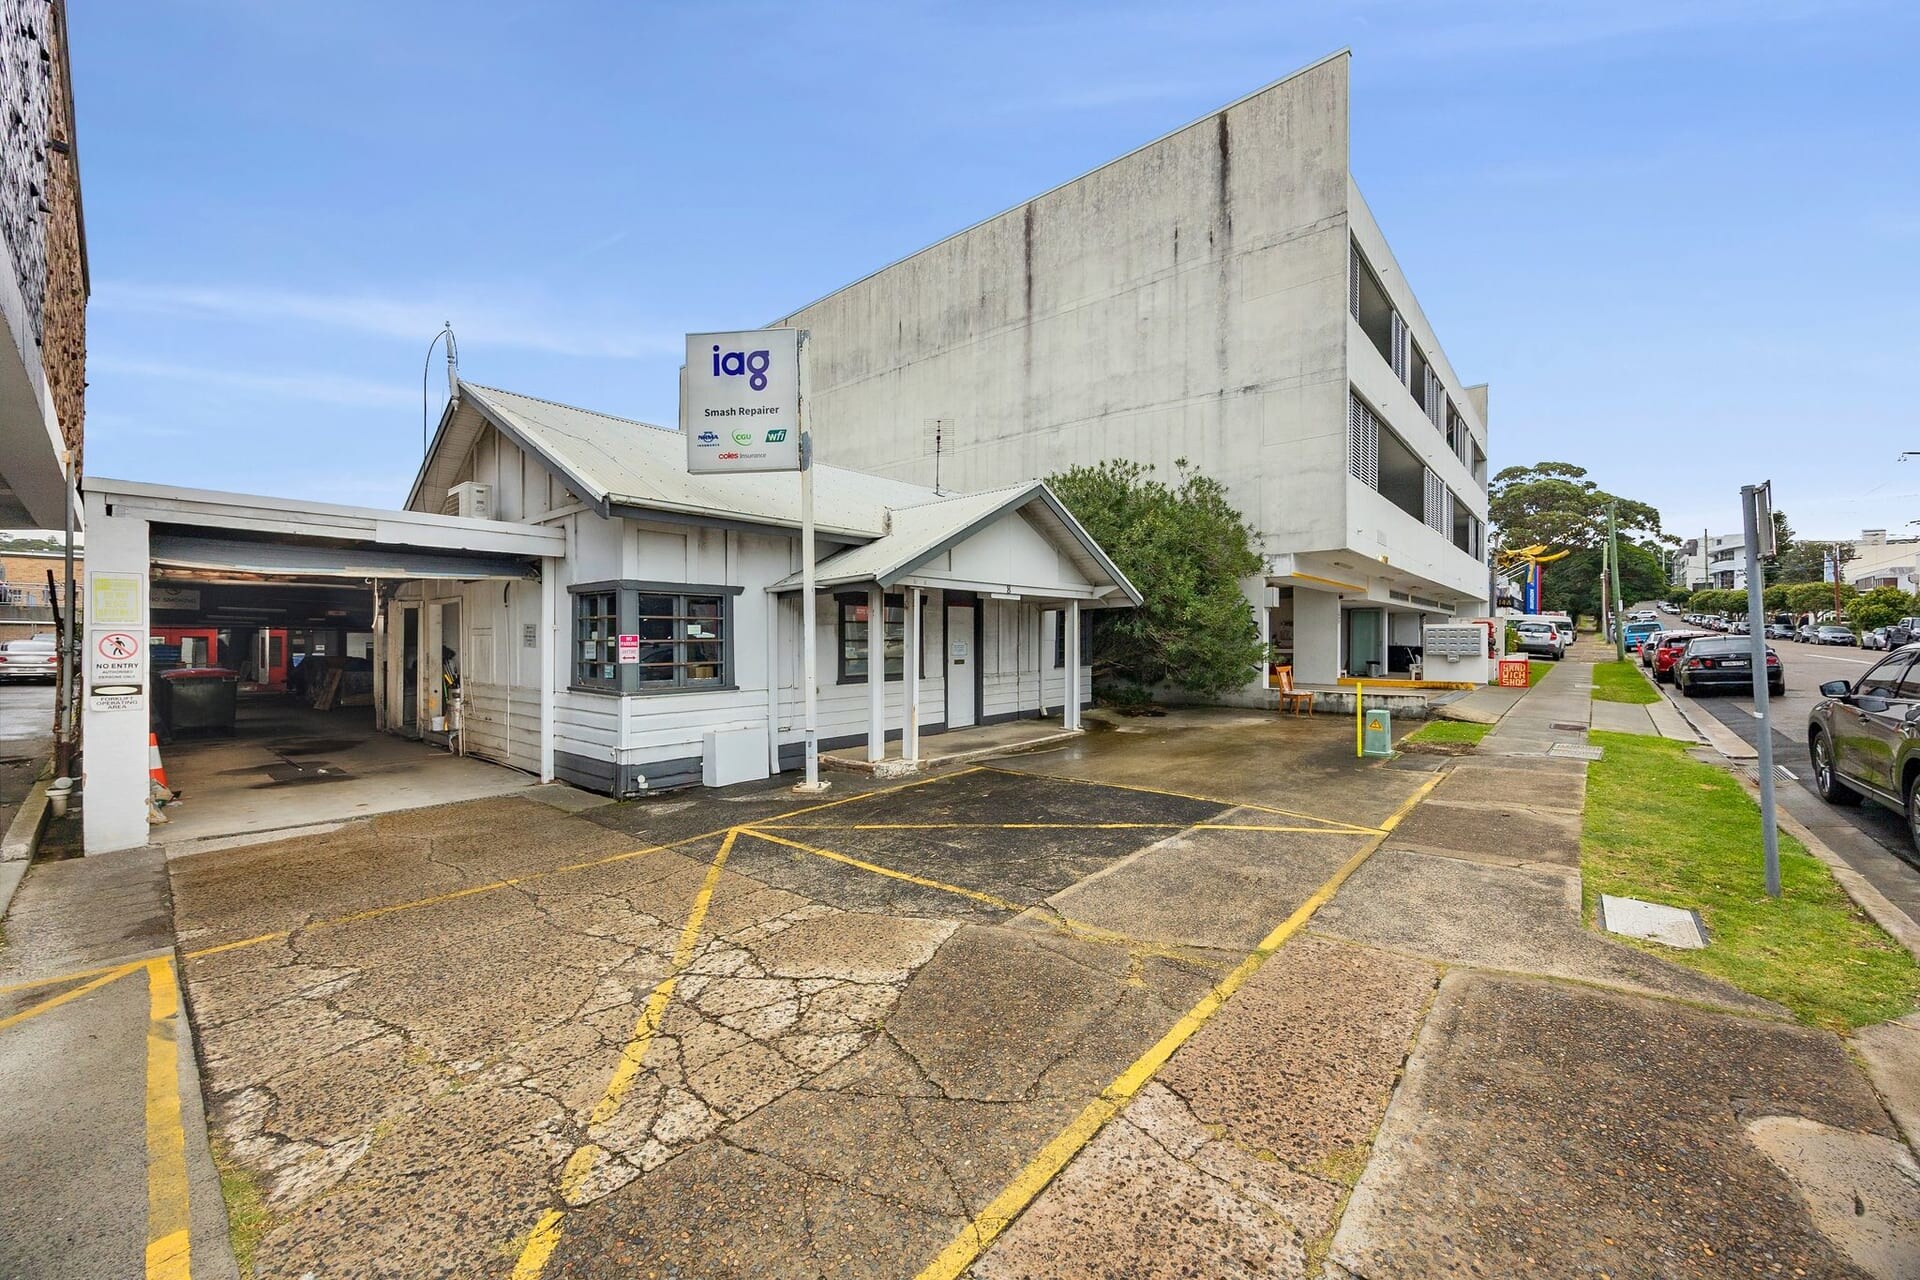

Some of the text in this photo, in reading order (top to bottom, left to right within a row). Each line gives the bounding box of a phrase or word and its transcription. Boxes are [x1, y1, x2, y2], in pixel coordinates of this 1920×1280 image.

[713, 345, 769, 391] iag
[704, 406, 780, 417] Smash Repairer
[718, 452, 739, 460] coles
